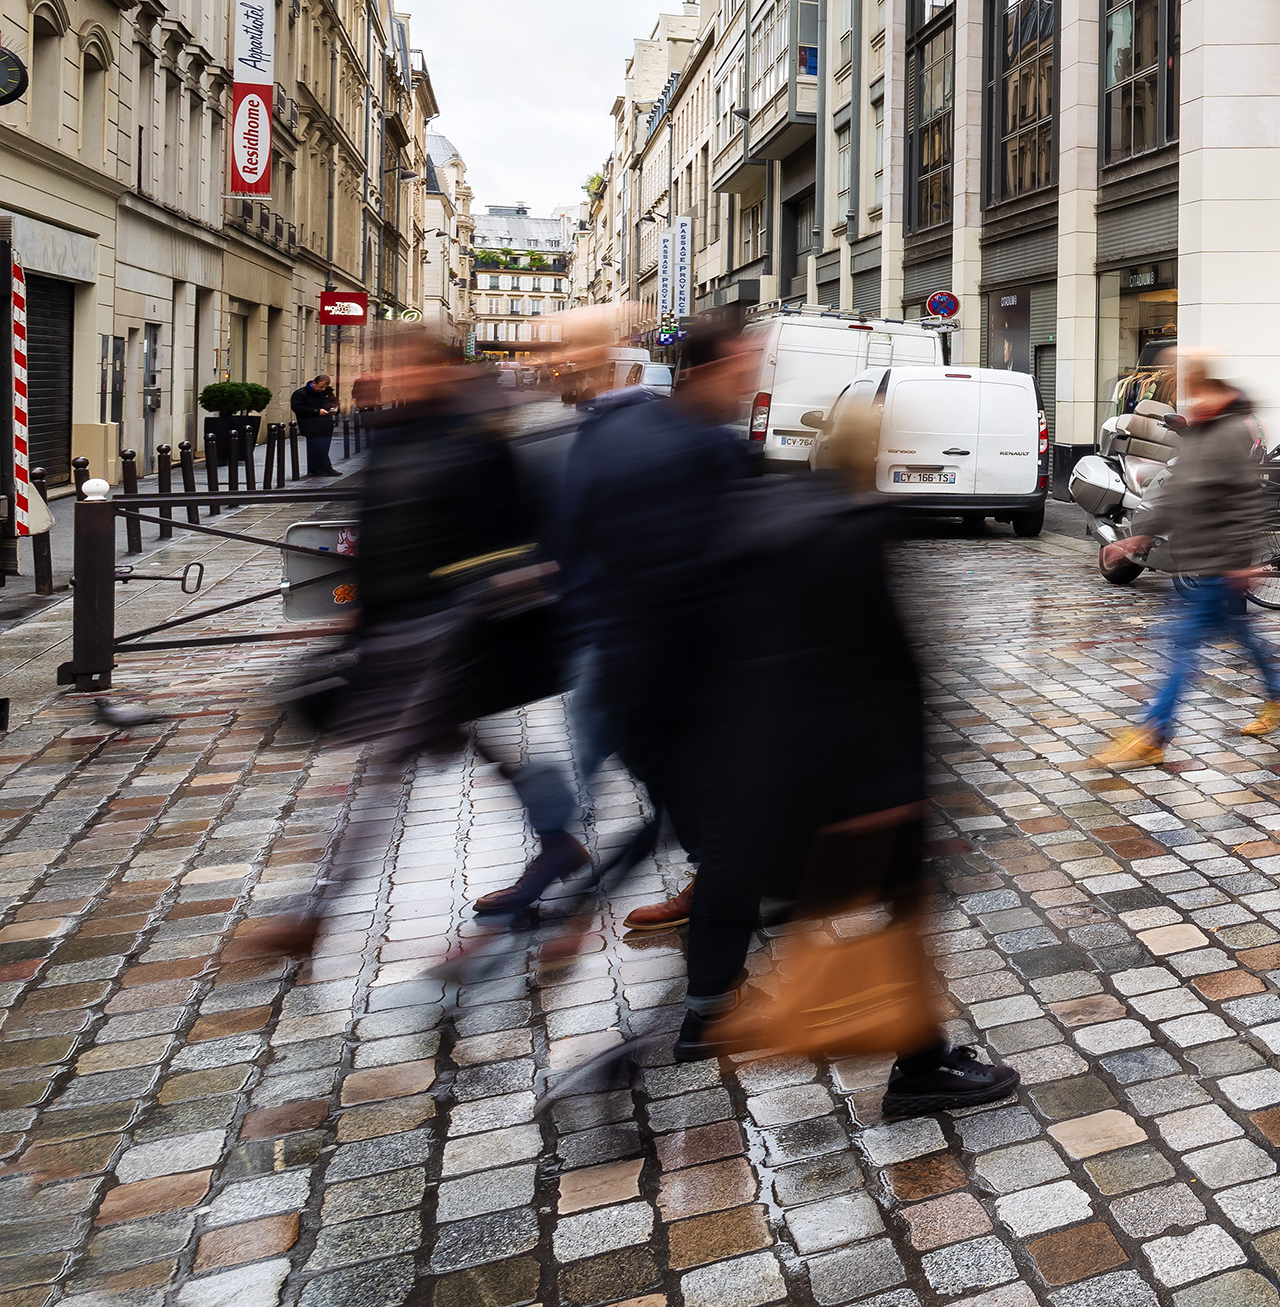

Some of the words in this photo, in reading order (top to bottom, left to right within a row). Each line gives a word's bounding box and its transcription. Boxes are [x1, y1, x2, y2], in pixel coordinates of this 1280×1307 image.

[238, 1, 272, 73] Apparthotel
[242, 99, 260, 176] Residhome
[680, 222, 688, 263] PASSAGE
[679, 265, 687, 317] PROVENCE
